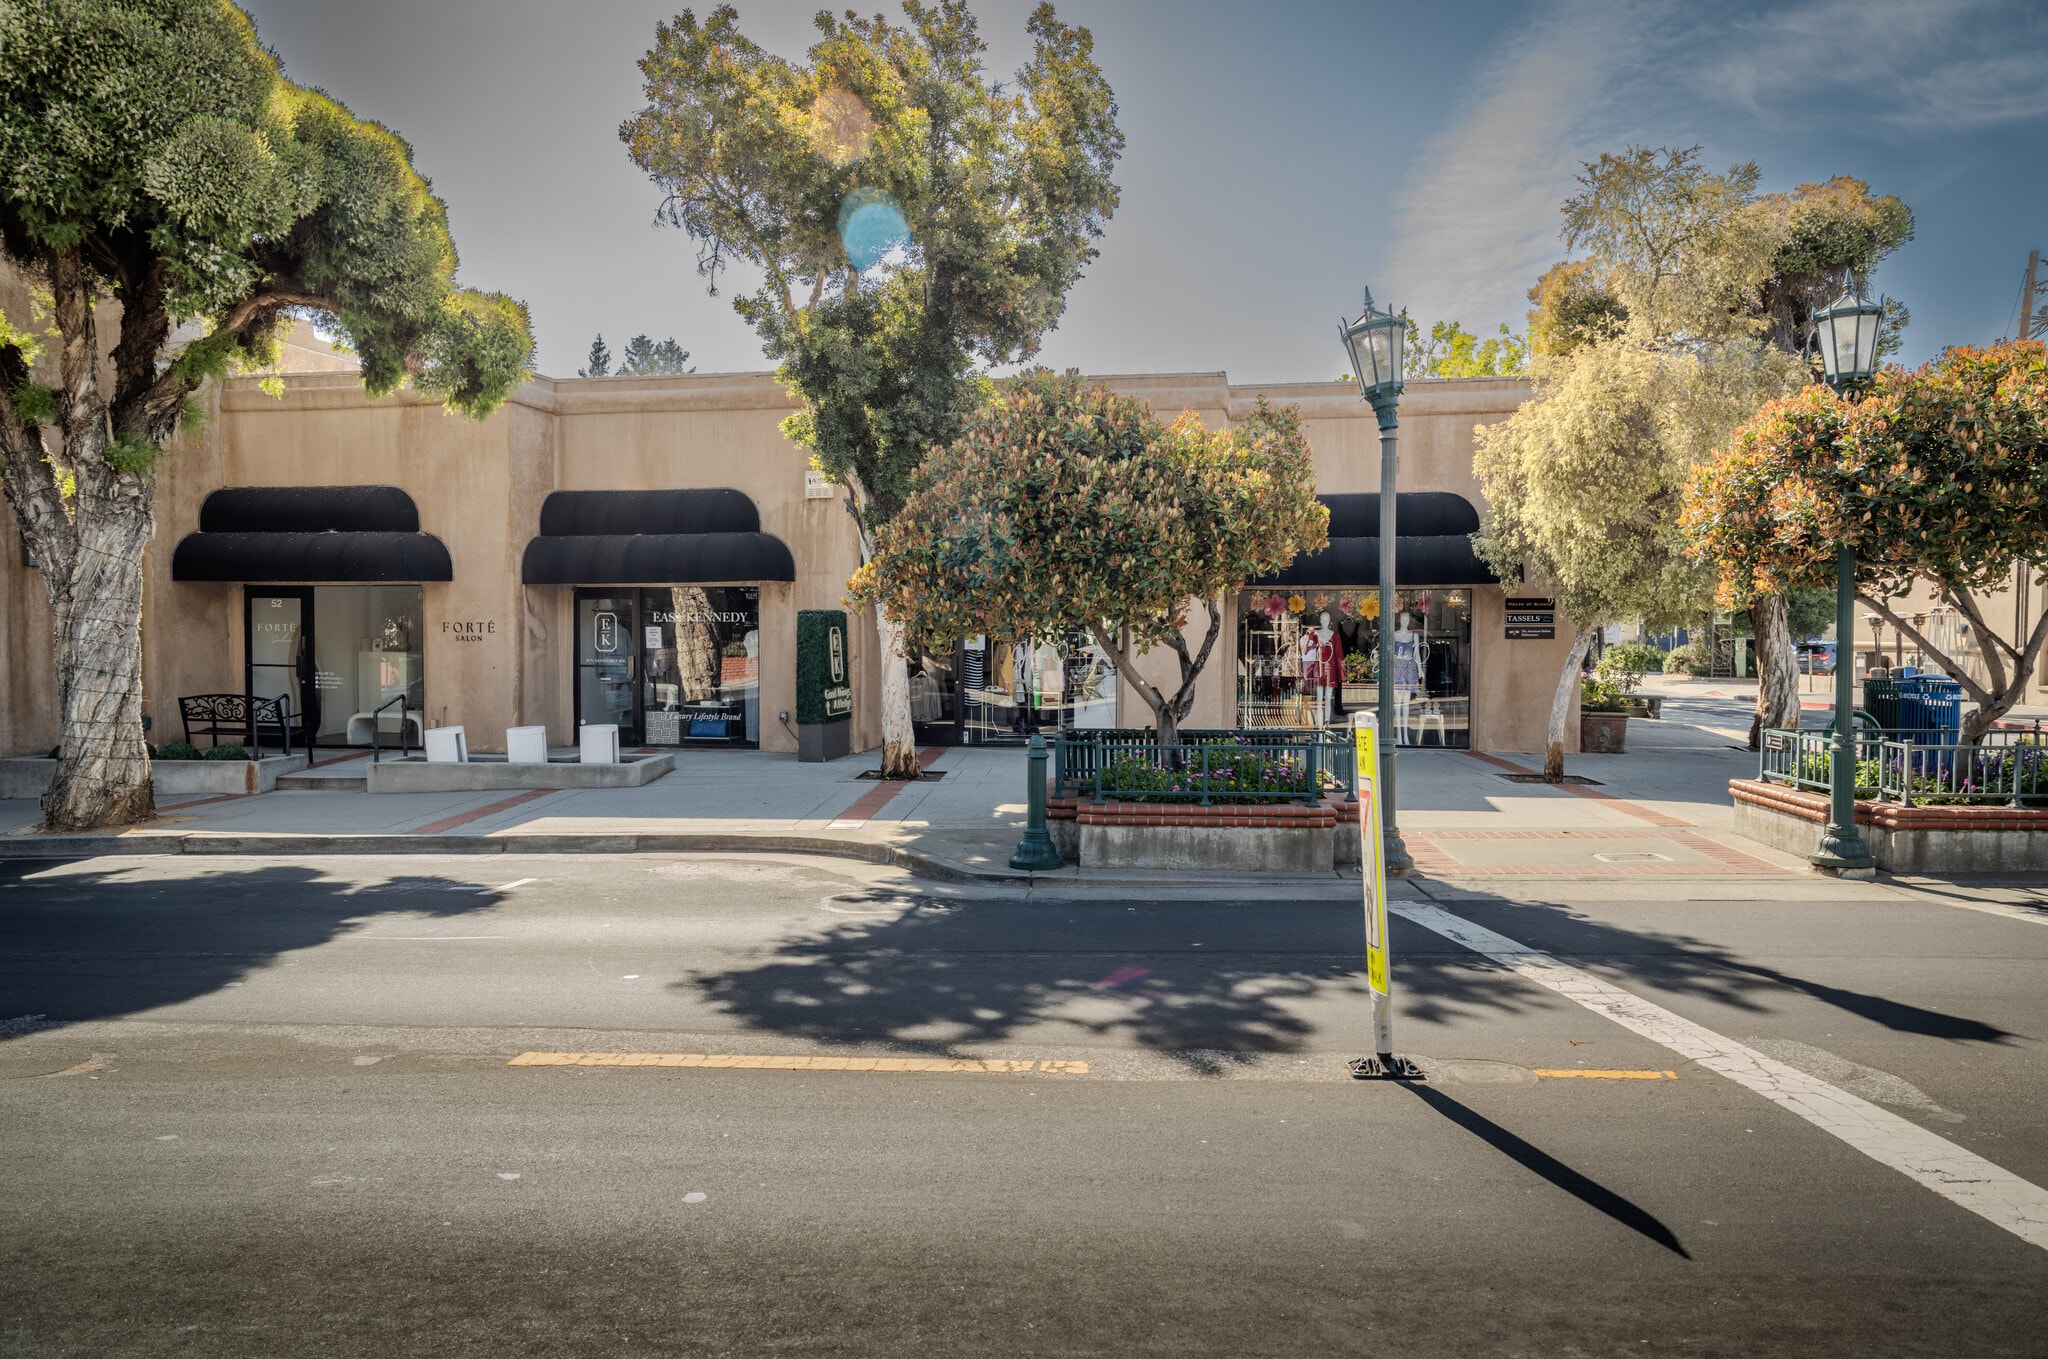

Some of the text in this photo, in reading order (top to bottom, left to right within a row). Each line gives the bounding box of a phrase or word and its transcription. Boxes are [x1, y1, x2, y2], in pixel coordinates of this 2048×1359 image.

[271, 599, 283, 608] 52
[686, 611, 748, 622] KENNEDY
[257, 622, 296, 632] FORTÉ
[442, 620, 496, 633] FORTÉ
[601, 618, 611, 630] E
[601, 634, 611, 645] K
[824, 688, 837, 700] Good
[694, 712, 720, 722] Lifestyle
[721, 713, 742, 721] Brand
